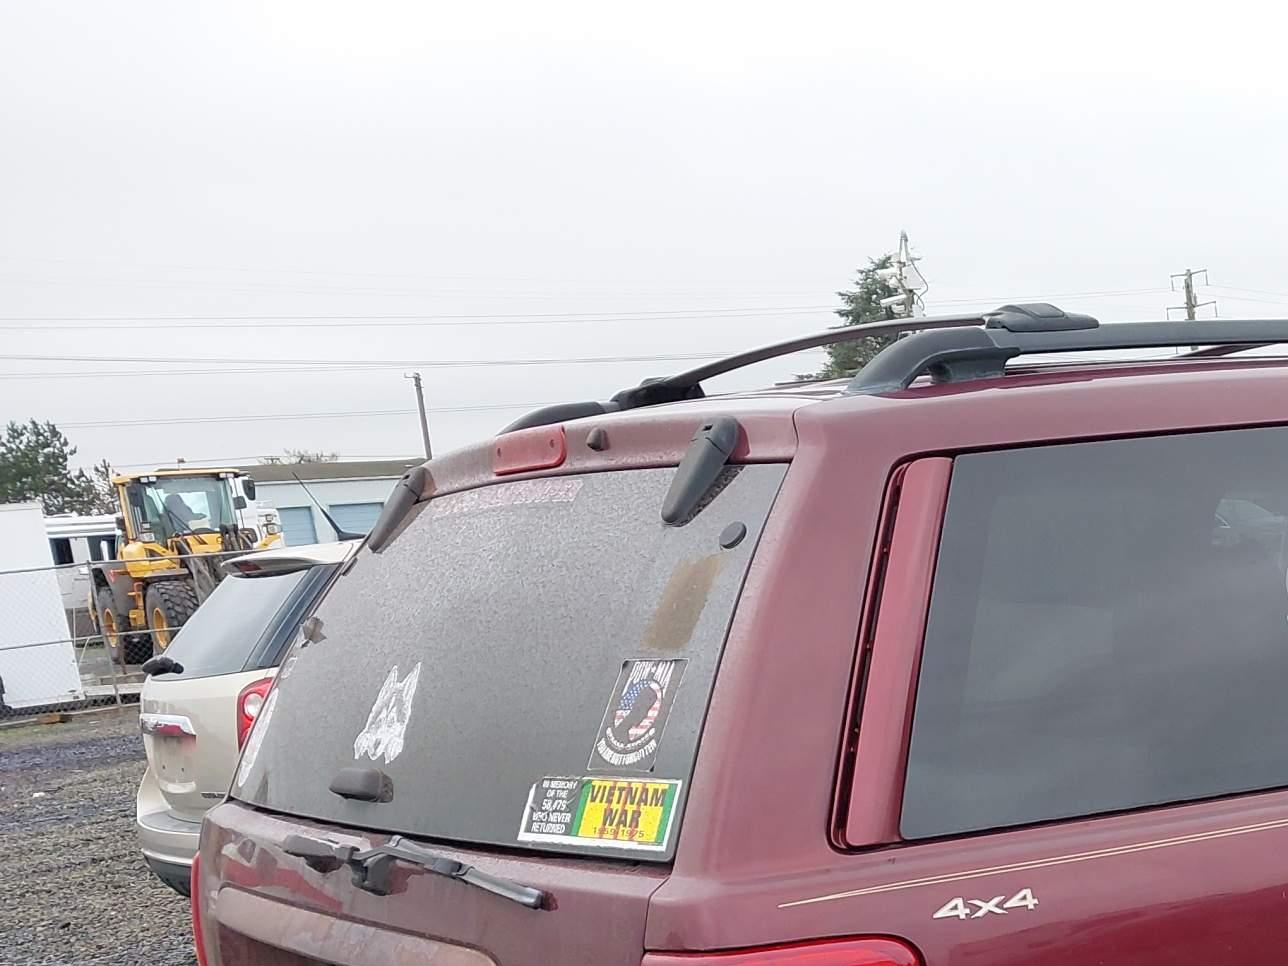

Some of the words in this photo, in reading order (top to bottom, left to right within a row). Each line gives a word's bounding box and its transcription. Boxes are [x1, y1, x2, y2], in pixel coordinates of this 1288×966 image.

[621, 661, 654, 696] POW
[653, 661, 676, 697] MIA
[550, 780, 577, 790] MEMORY
[546, 789, 555, 798] OF
[556, 790, 568, 798] THE
[590, 785, 668, 807] VIETNAM
[532, 812, 548, 821] WHO
[549, 812, 571, 823] NEVER
[602, 807, 641, 828] WAR
[531, 822, 566, 834] RETURNED
